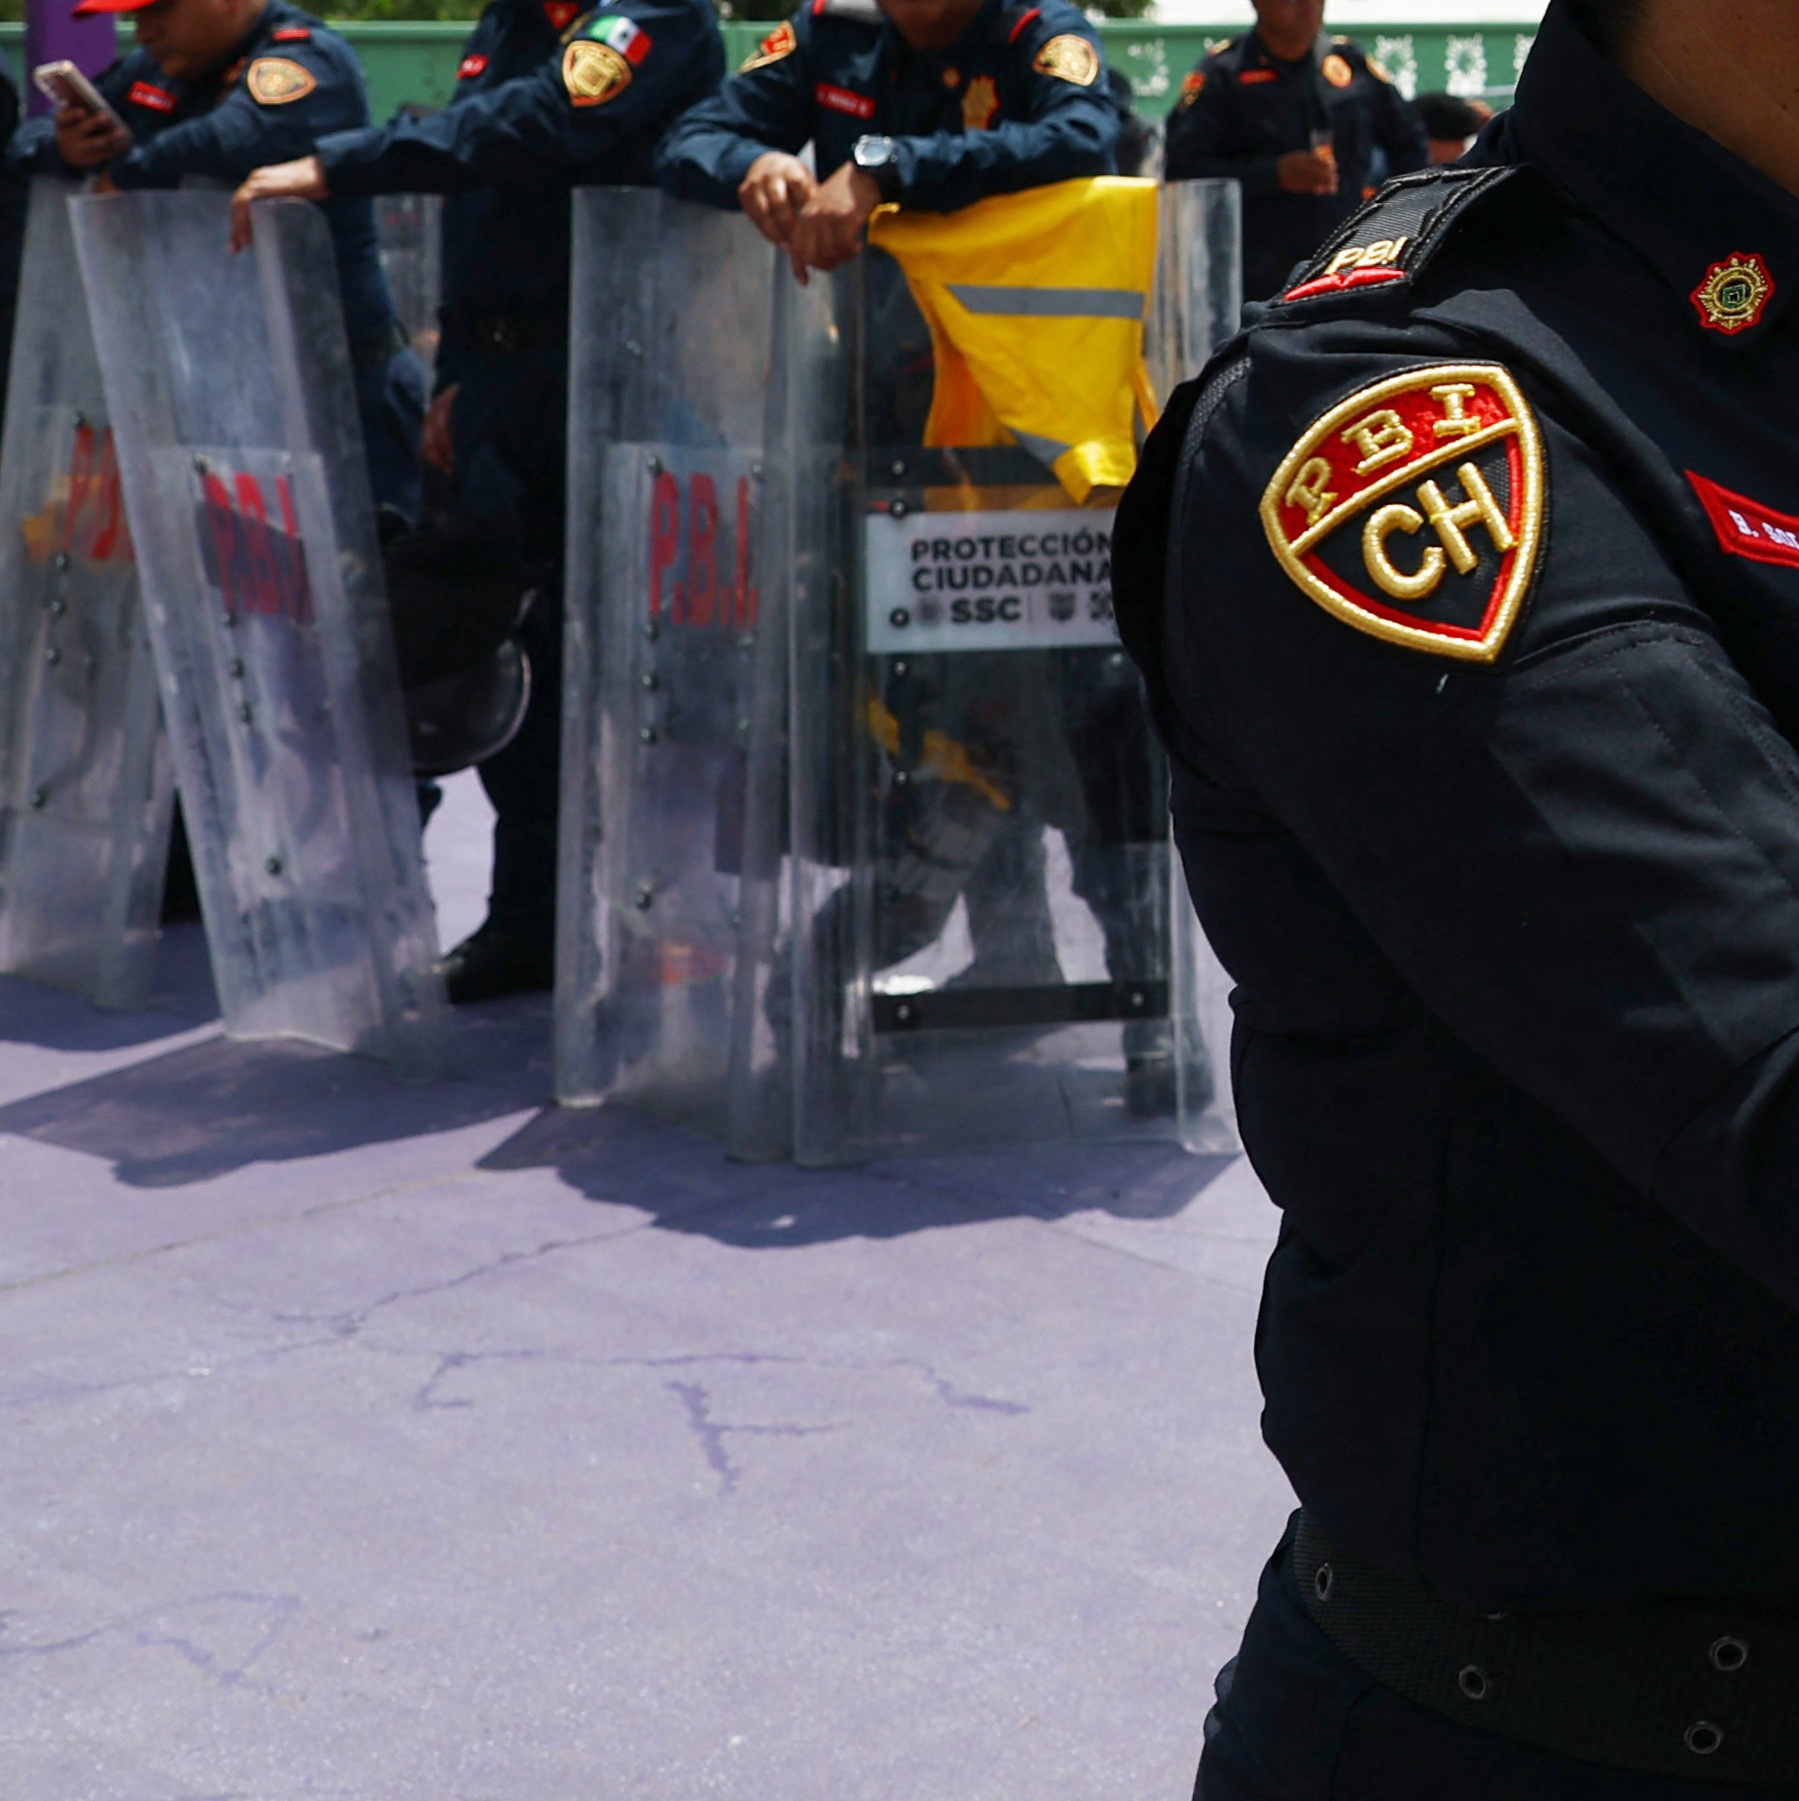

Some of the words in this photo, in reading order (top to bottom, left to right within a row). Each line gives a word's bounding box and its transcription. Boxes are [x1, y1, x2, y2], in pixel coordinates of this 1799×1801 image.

[1322, 235, 1408, 276] PBI
[911, 525, 1113, 562] PROTECCIÓN
[1361, 461, 1518, 601] CH
[951, 597, 1021, 624] SSC
